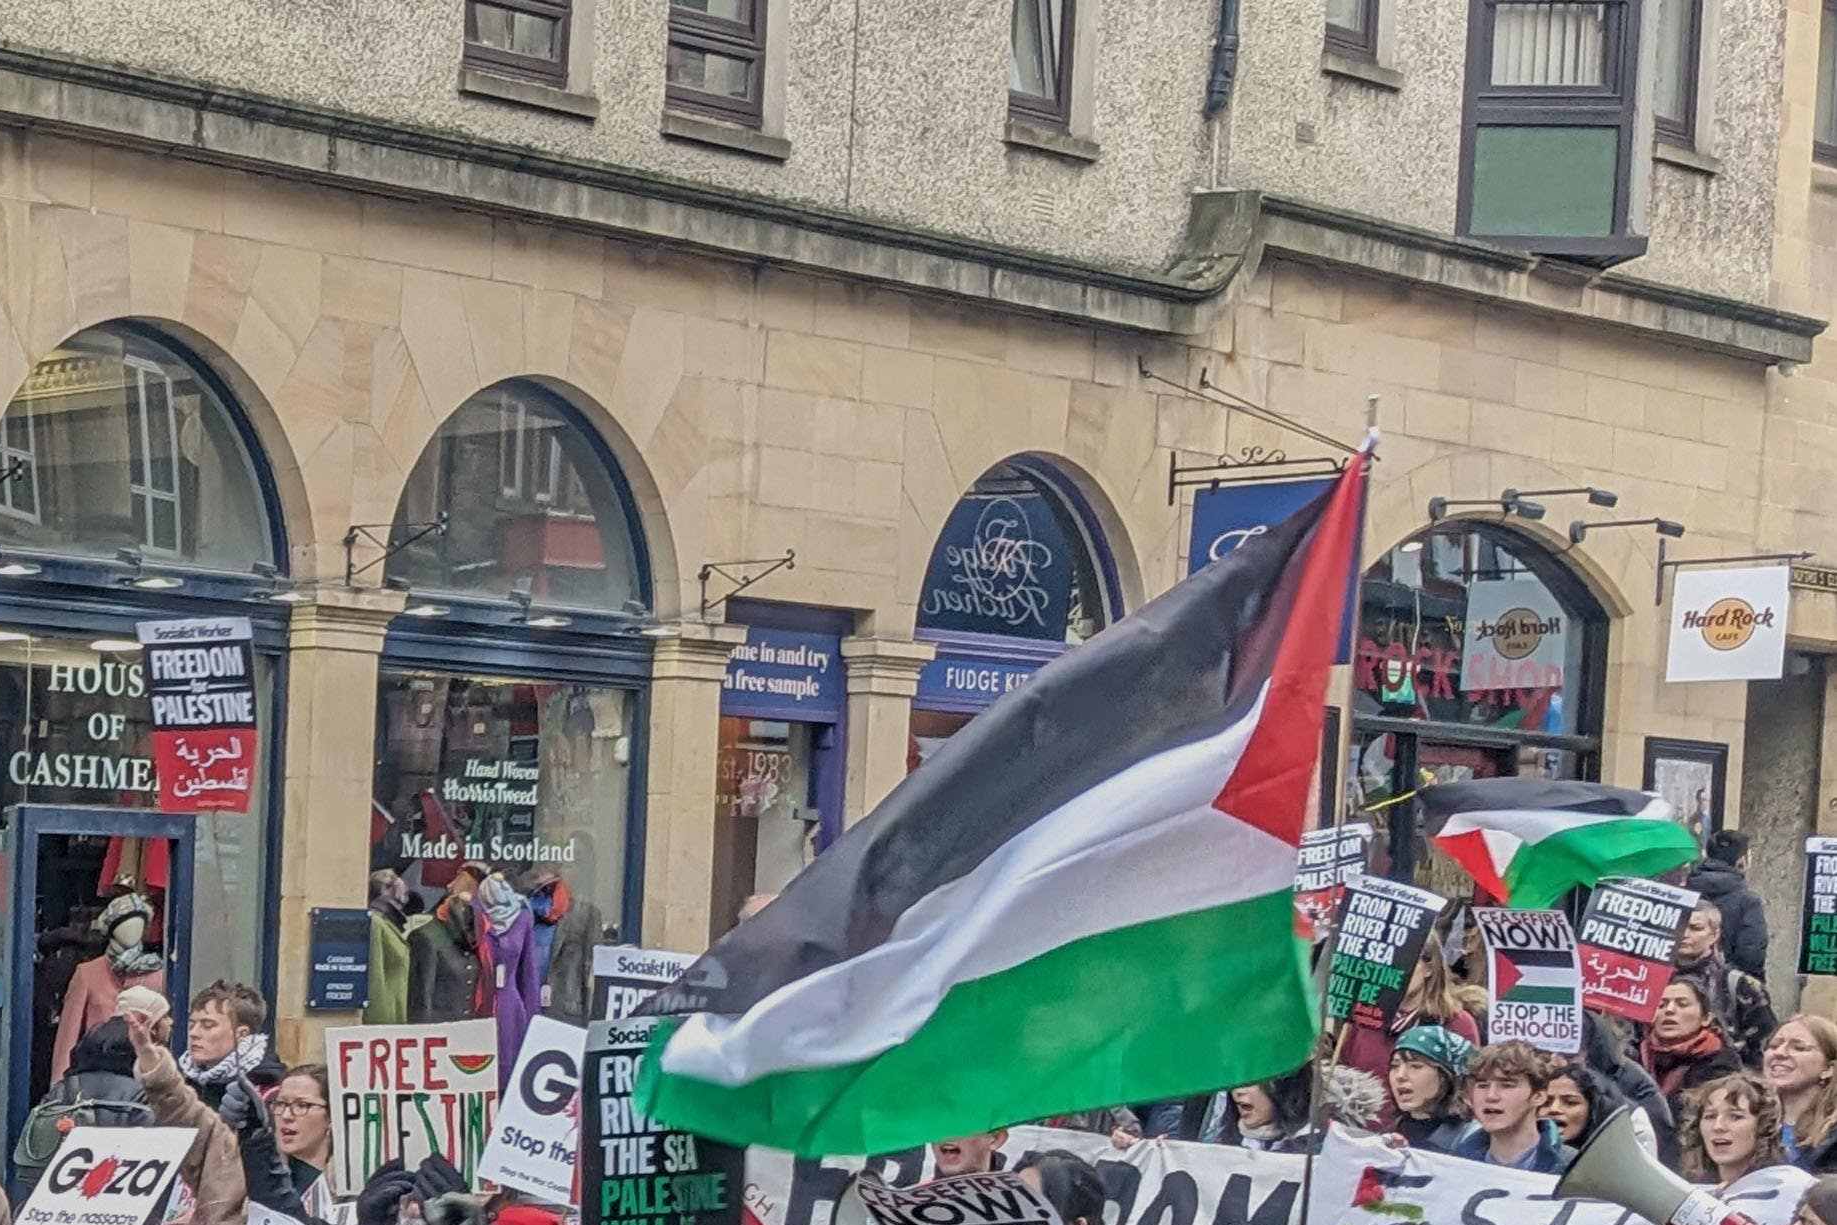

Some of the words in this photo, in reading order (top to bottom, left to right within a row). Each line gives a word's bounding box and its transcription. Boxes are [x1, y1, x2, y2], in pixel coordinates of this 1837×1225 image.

[1682, 609, 1729, 629] Hard
[1730, 607, 1774, 630] Rock
[150, 646, 245, 680] FREEDOM
[760, 641, 776, 663] in
[777, 645, 805, 666] and
[807, 648, 830, 674] try
[47, 662, 148, 698] HOUS
[735, 669, 765, 691] free
[767, 675, 820, 701] sample
[945, 667, 999, 692] FUDGE
[153, 691, 254, 726] PALESTINE
[87, 712, 126, 741] OF
[8, 751, 160, 792] CASHME
[464, 758, 500, 779] Hand
[503, 760, 539, 780] Woven
[443, 777, 495, 803] Harris
[494, 782, 538, 806] Tweed
[400, 833, 459, 860] Made
[463, 835, 485, 861] in
[490, 835, 576, 862] Scotland
[1348, 892, 1393, 921] FROM
[1392, 903, 1424, 929] THE
[1478, 910, 1565, 929] CEASEFIRE
[1596, 889, 1683, 930] FREEDOM
[1342, 912, 1386, 941] RIVER
[1387, 923, 1409, 947] TO
[1484, 922, 1574, 950] NOW!
[1580, 919, 1676, 962] PALESTINE
[1336, 932, 1366, 957] THE
[1364, 940, 1396, 966] SEA
[617, 956, 665, 976] Socialist
[1330, 952, 1405, 991] PALESTINE
[1327, 994, 1352, 1019] REE
[1357, 982, 1381, 1006] BE
[1494, 1003, 1543, 1021] STOP
[1547, 1005, 1576, 1023] THE
[1490, 1019, 1580, 1041] GENOCIDE
[339, 1037, 449, 1091] FREE
[341, 1090, 500, 1192] PALESTINE
[500, 1126, 545, 1157] Stop
[548, 1140, 579, 1166] the
[600, 1136, 657, 1176] THE
[663, 1134, 698, 1173] SEA
[48, 1147, 170, 1198] Gza
[600, 1172, 728, 1217] PALESTINE
[857, 1174, 1017, 1206] CEASEFIRE
[24, 1207, 54, 1225] Stop
[55, 1209, 77, 1224] the
